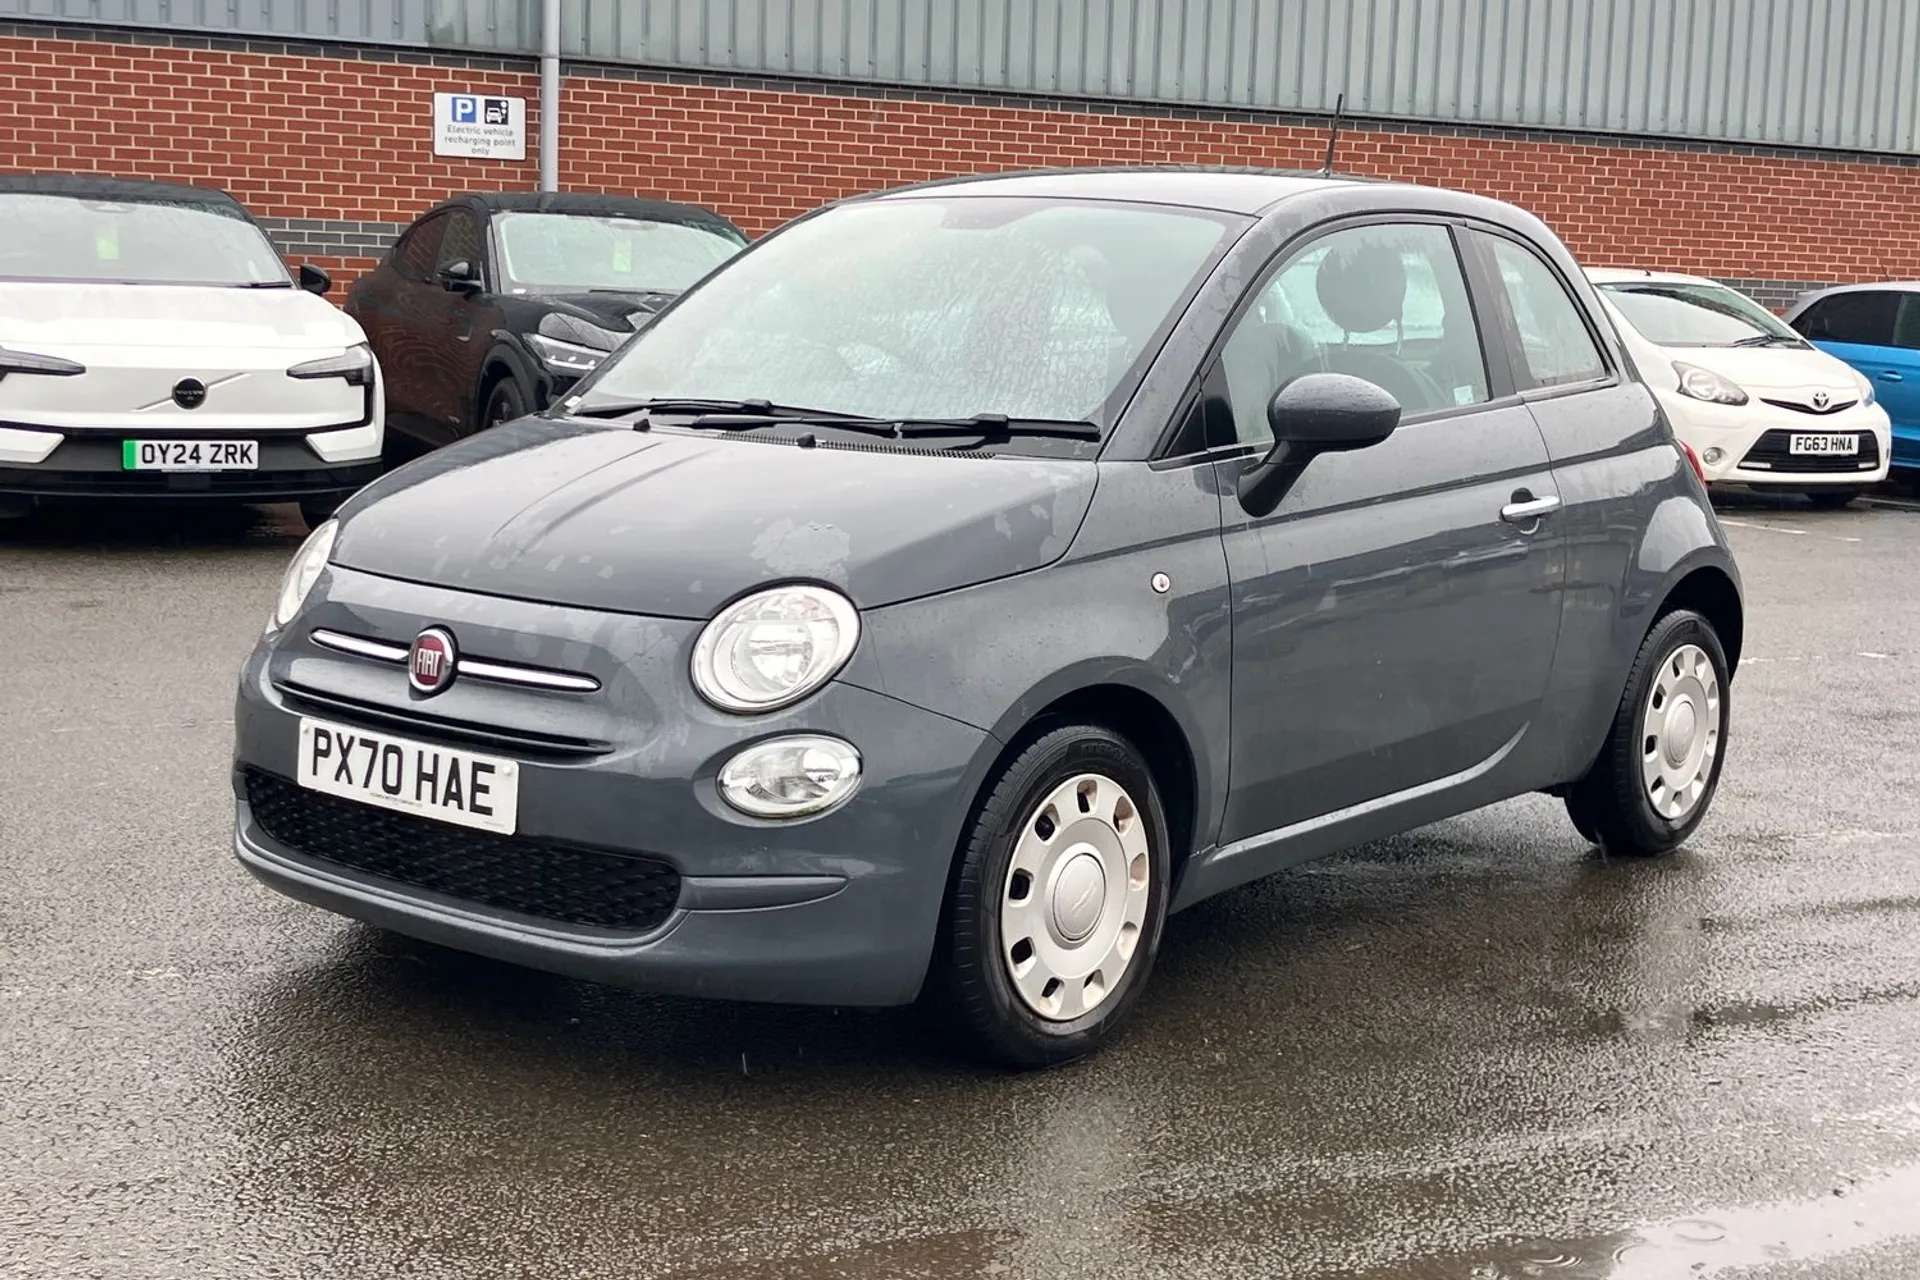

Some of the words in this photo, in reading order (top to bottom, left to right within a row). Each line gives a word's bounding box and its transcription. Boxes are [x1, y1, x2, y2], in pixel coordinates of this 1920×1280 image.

[455, 99, 473, 121] P
[447, 124, 481, 135] Electric
[483, 127, 513, 136] vehicle
[444, 136, 491, 146] recharging
[493, 138, 515, 147] point
[471, 147, 490, 155] only
[1796, 437, 1828, 451] FG63
[1831, 437, 1853, 451] HNA
[142, 444, 201, 464] OY24
[209, 444, 253, 464] ZRK
[416, 647, 442, 677] FIAT
[312, 727, 404, 795] PX70
[415, 750, 496, 816] HAE
